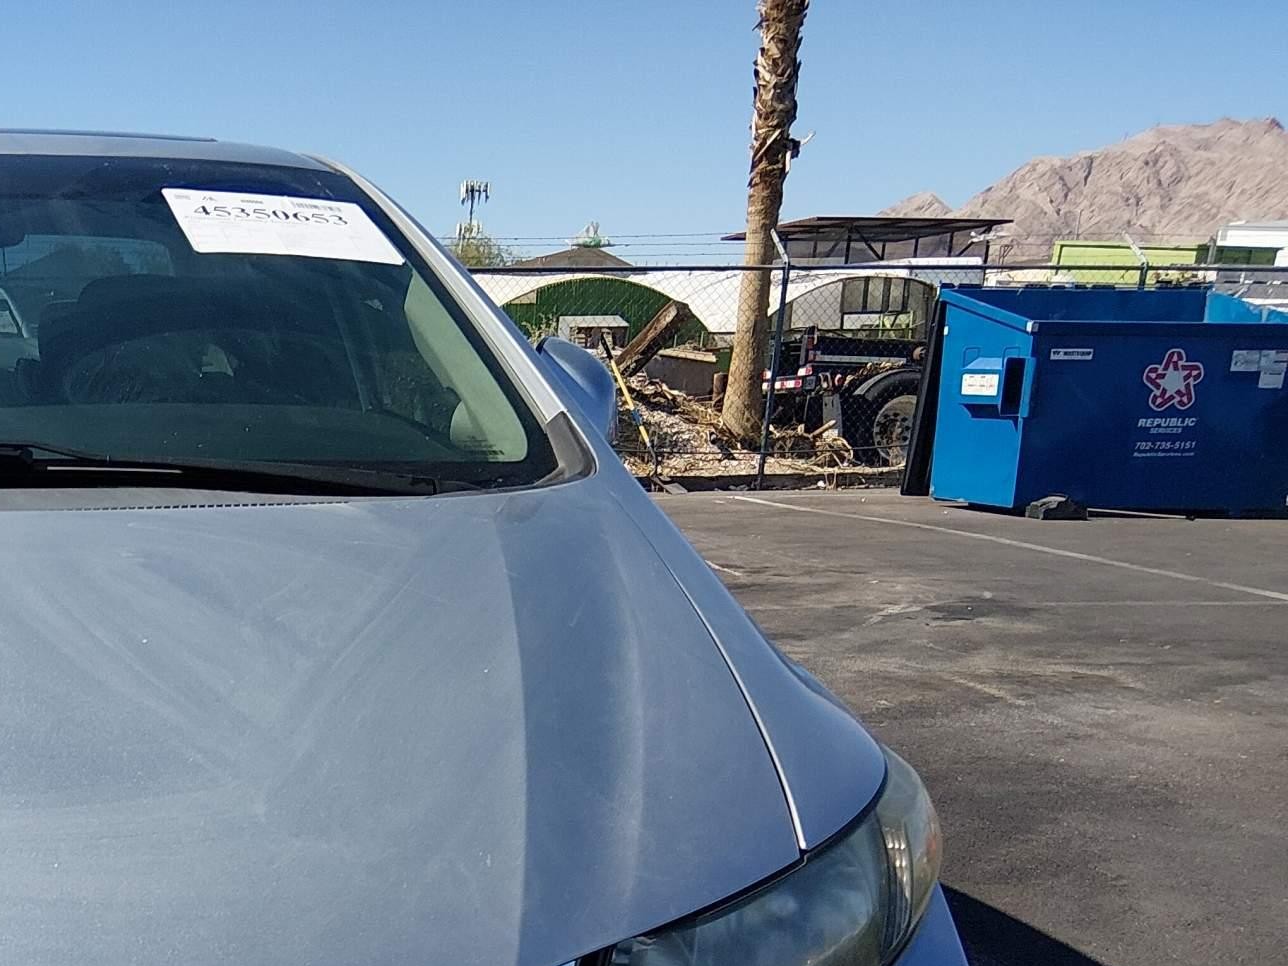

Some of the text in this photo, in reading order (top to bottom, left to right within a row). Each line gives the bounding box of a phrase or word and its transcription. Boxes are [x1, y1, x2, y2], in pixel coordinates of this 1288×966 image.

[193, 204, 348, 226] 45350653
[1137, 417, 1198, 428] REPUBLIC
[1134, 440, 1197, 450] 702-735-5151
